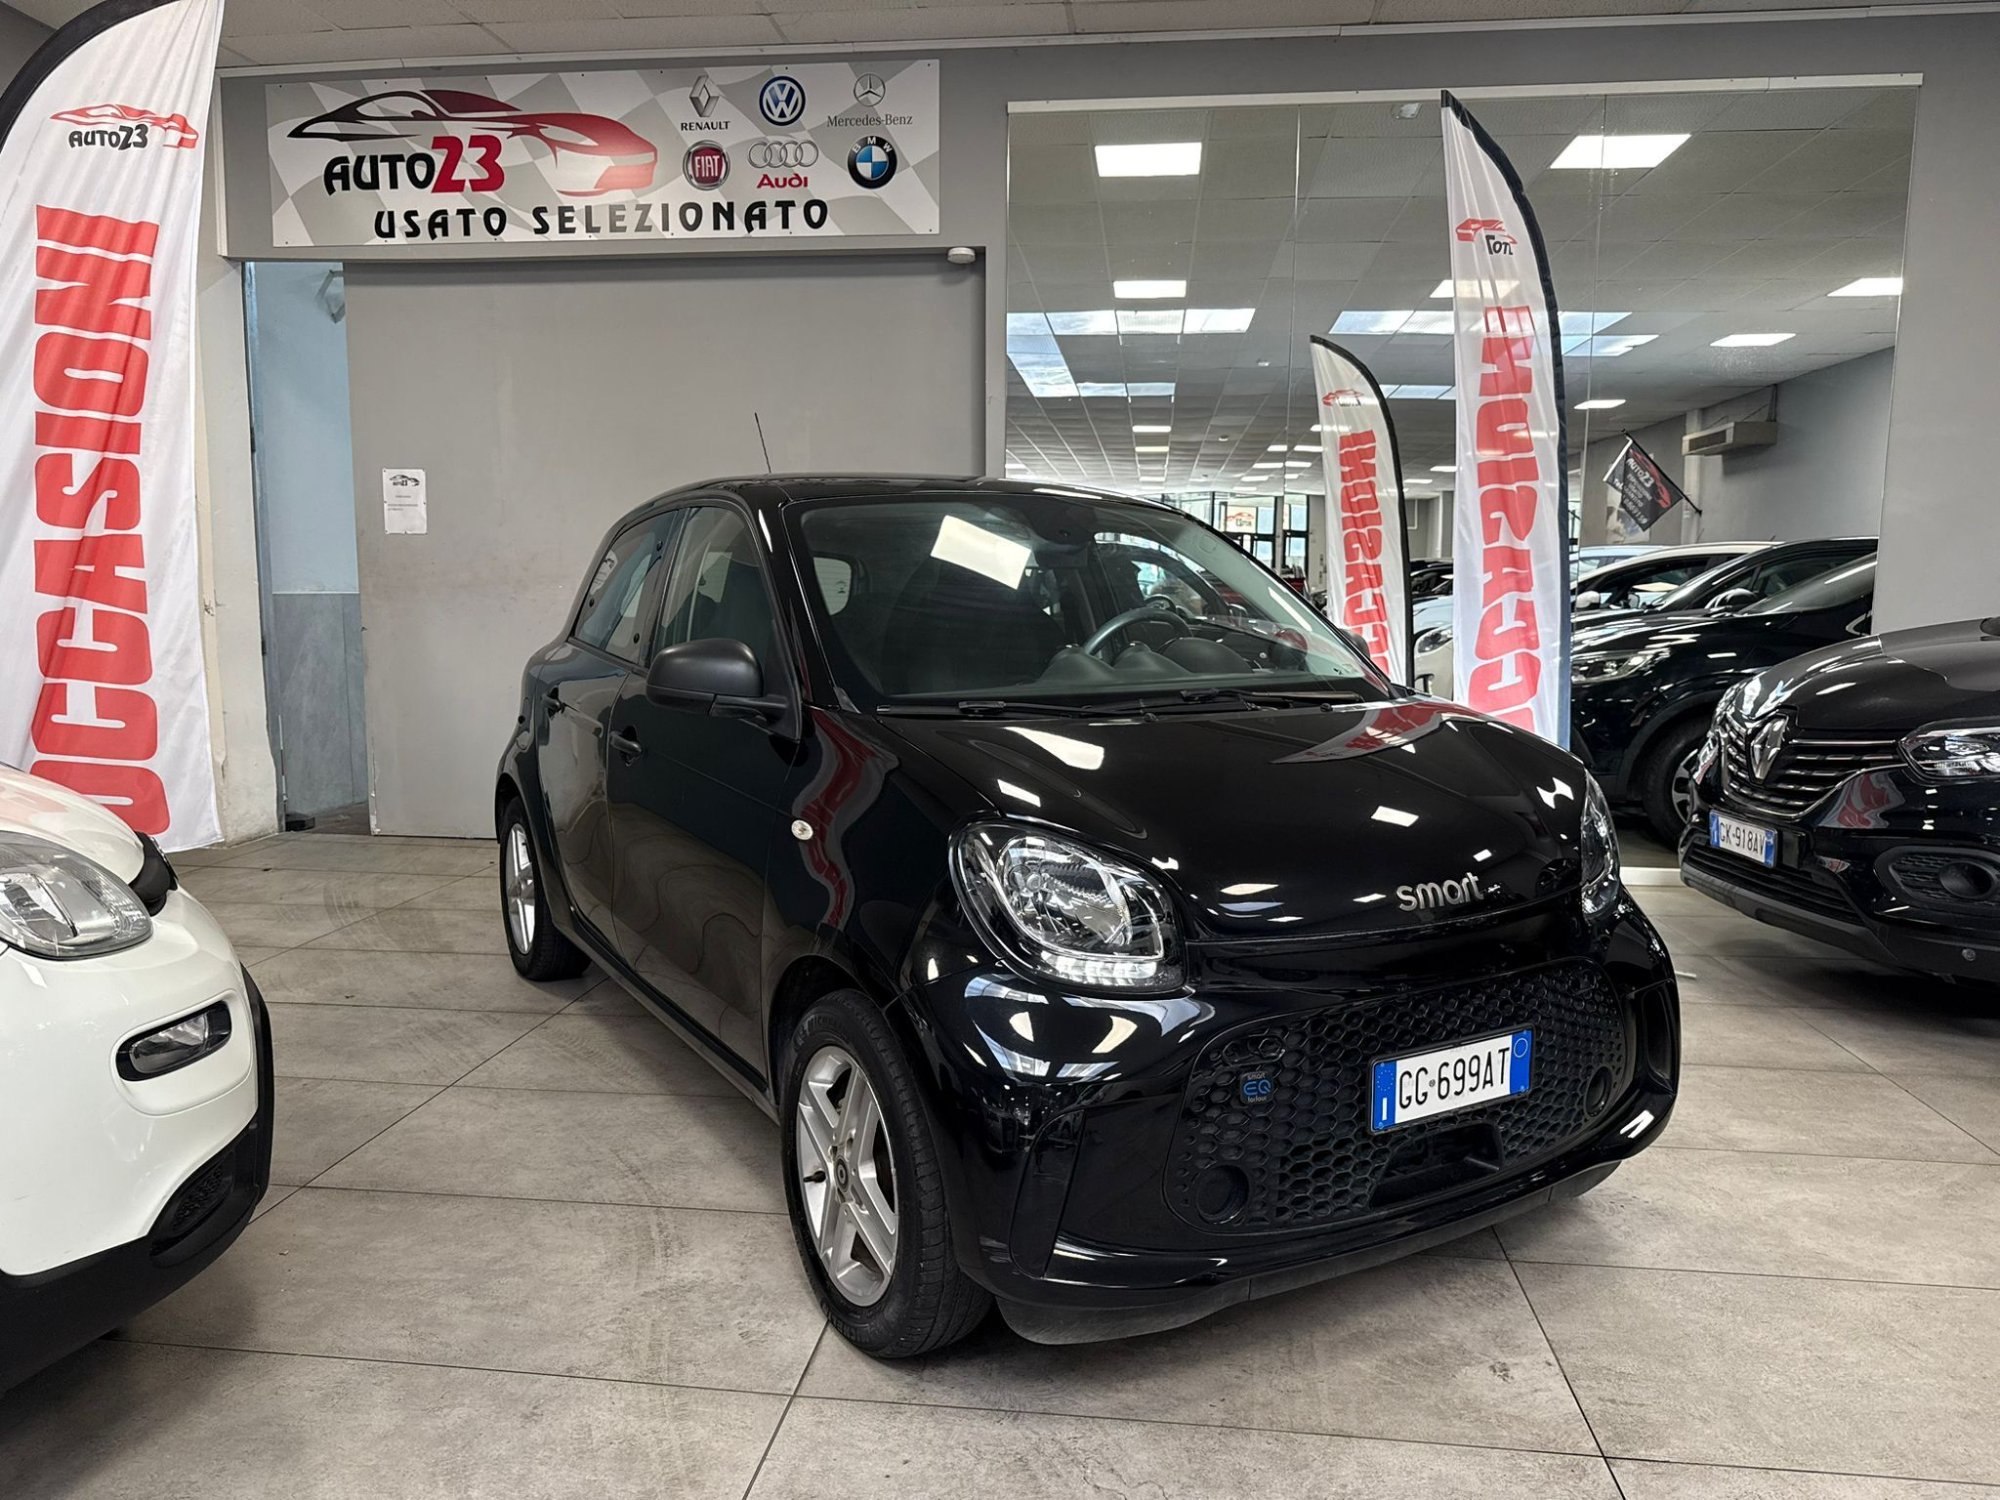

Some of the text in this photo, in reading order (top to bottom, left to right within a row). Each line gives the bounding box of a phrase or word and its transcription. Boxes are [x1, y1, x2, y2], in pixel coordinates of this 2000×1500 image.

[680, 121, 731, 132] RENAULT
[826, 113, 914, 128] Mercedes-Benz
[68, 123, 149, 150] AUTO23
[323, 134, 505, 196] AUTO23
[694, 154, 721, 178] FIAT
[756, 174, 809, 189] Audi
[374, 199, 828, 240] USATO SELEZIONATO
[1396, 871, 1485, 912] smart
[1243, 1079, 1271, 1096] EQ
